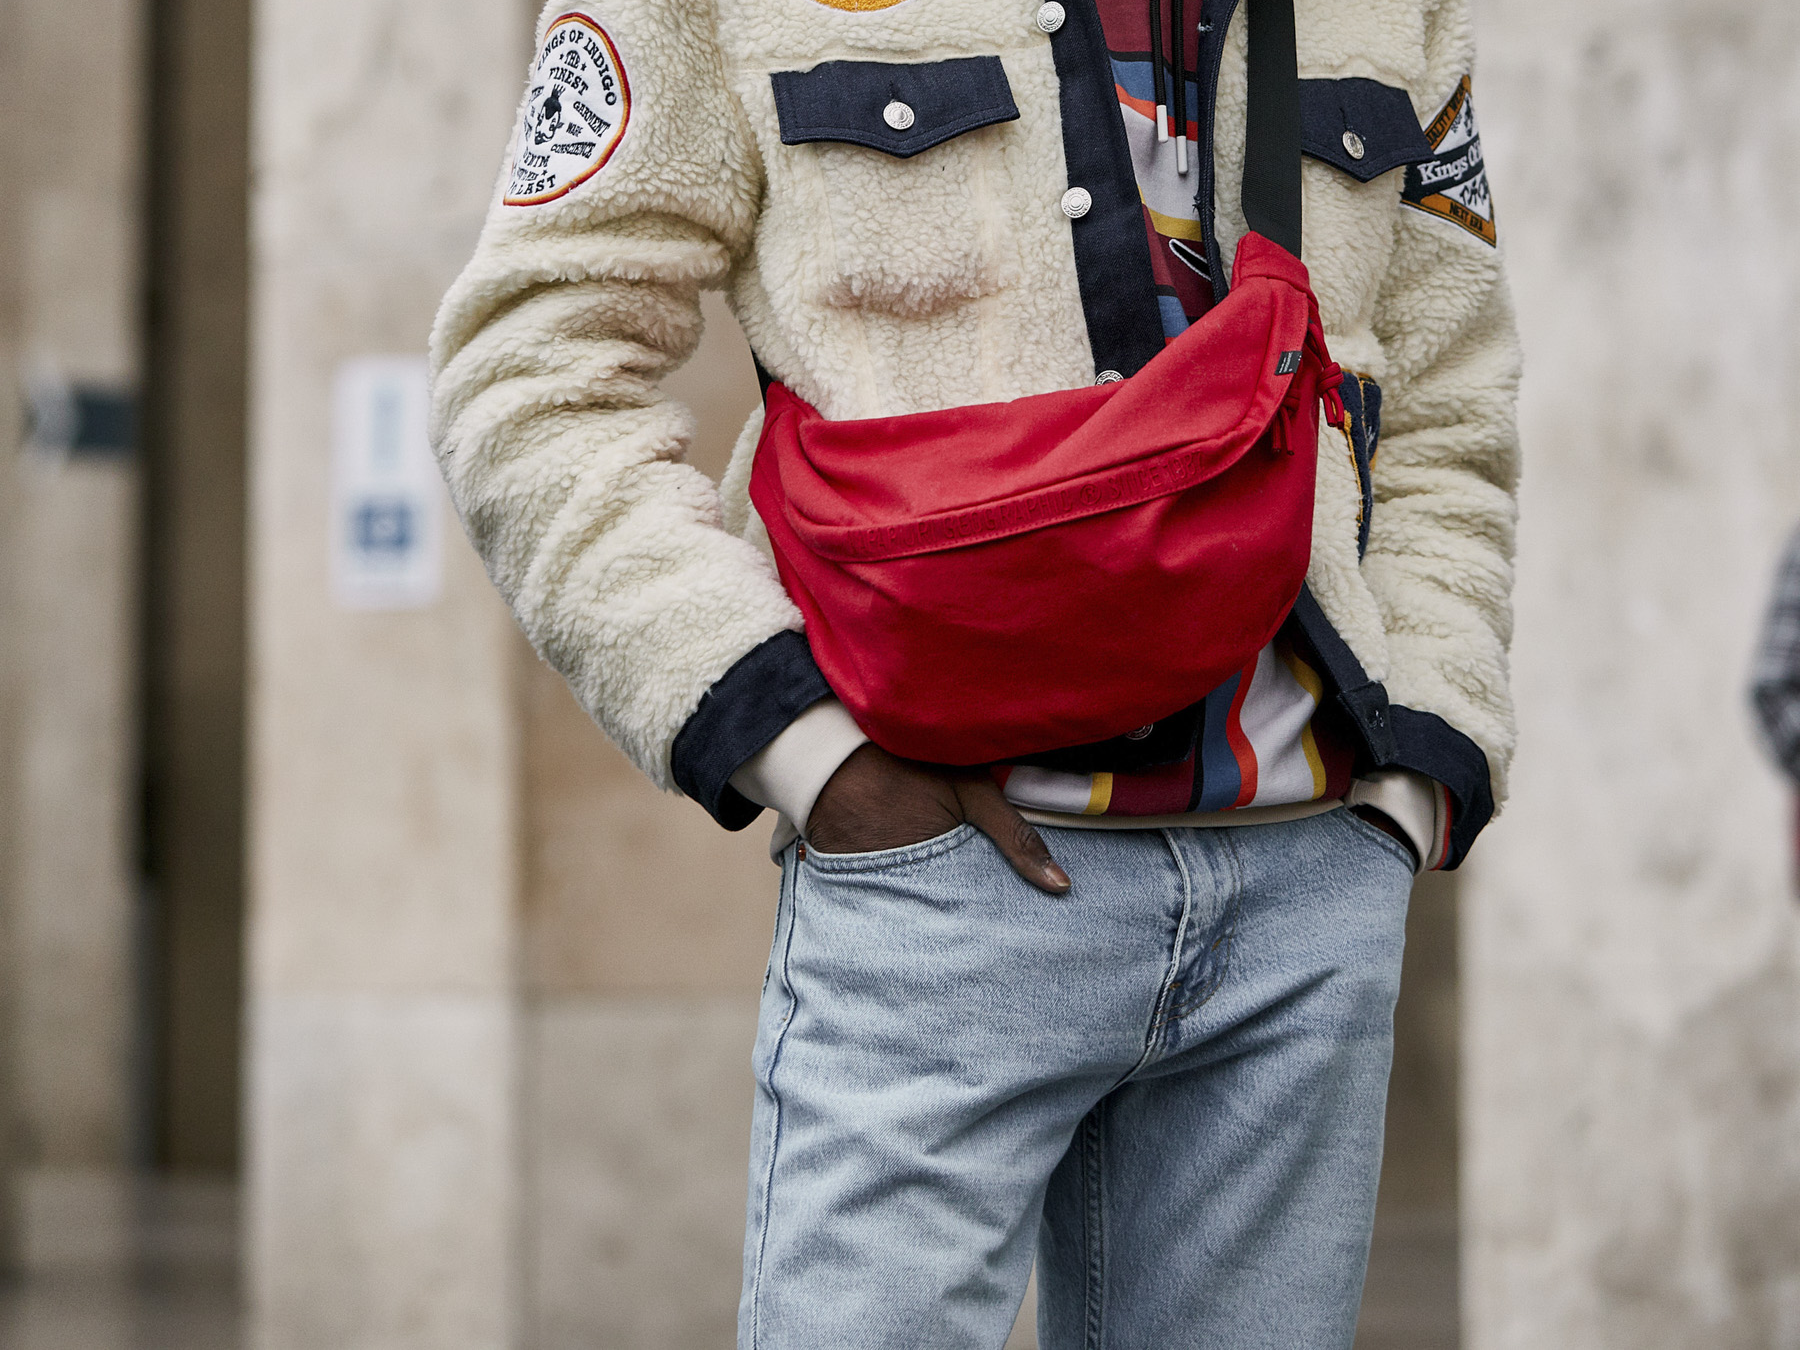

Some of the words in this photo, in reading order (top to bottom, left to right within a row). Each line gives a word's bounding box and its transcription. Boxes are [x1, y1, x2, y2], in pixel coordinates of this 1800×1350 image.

[564, 50, 580, 69] THE
[569, 29, 584, 44] OF
[582, 37, 617, 106] INDIGO
[548, 66, 589, 96] FINEST
[573, 100, 611, 138] GARMENT
[515, 174, 556, 195] LAST
[1416, 154, 1469, 186] Kings
